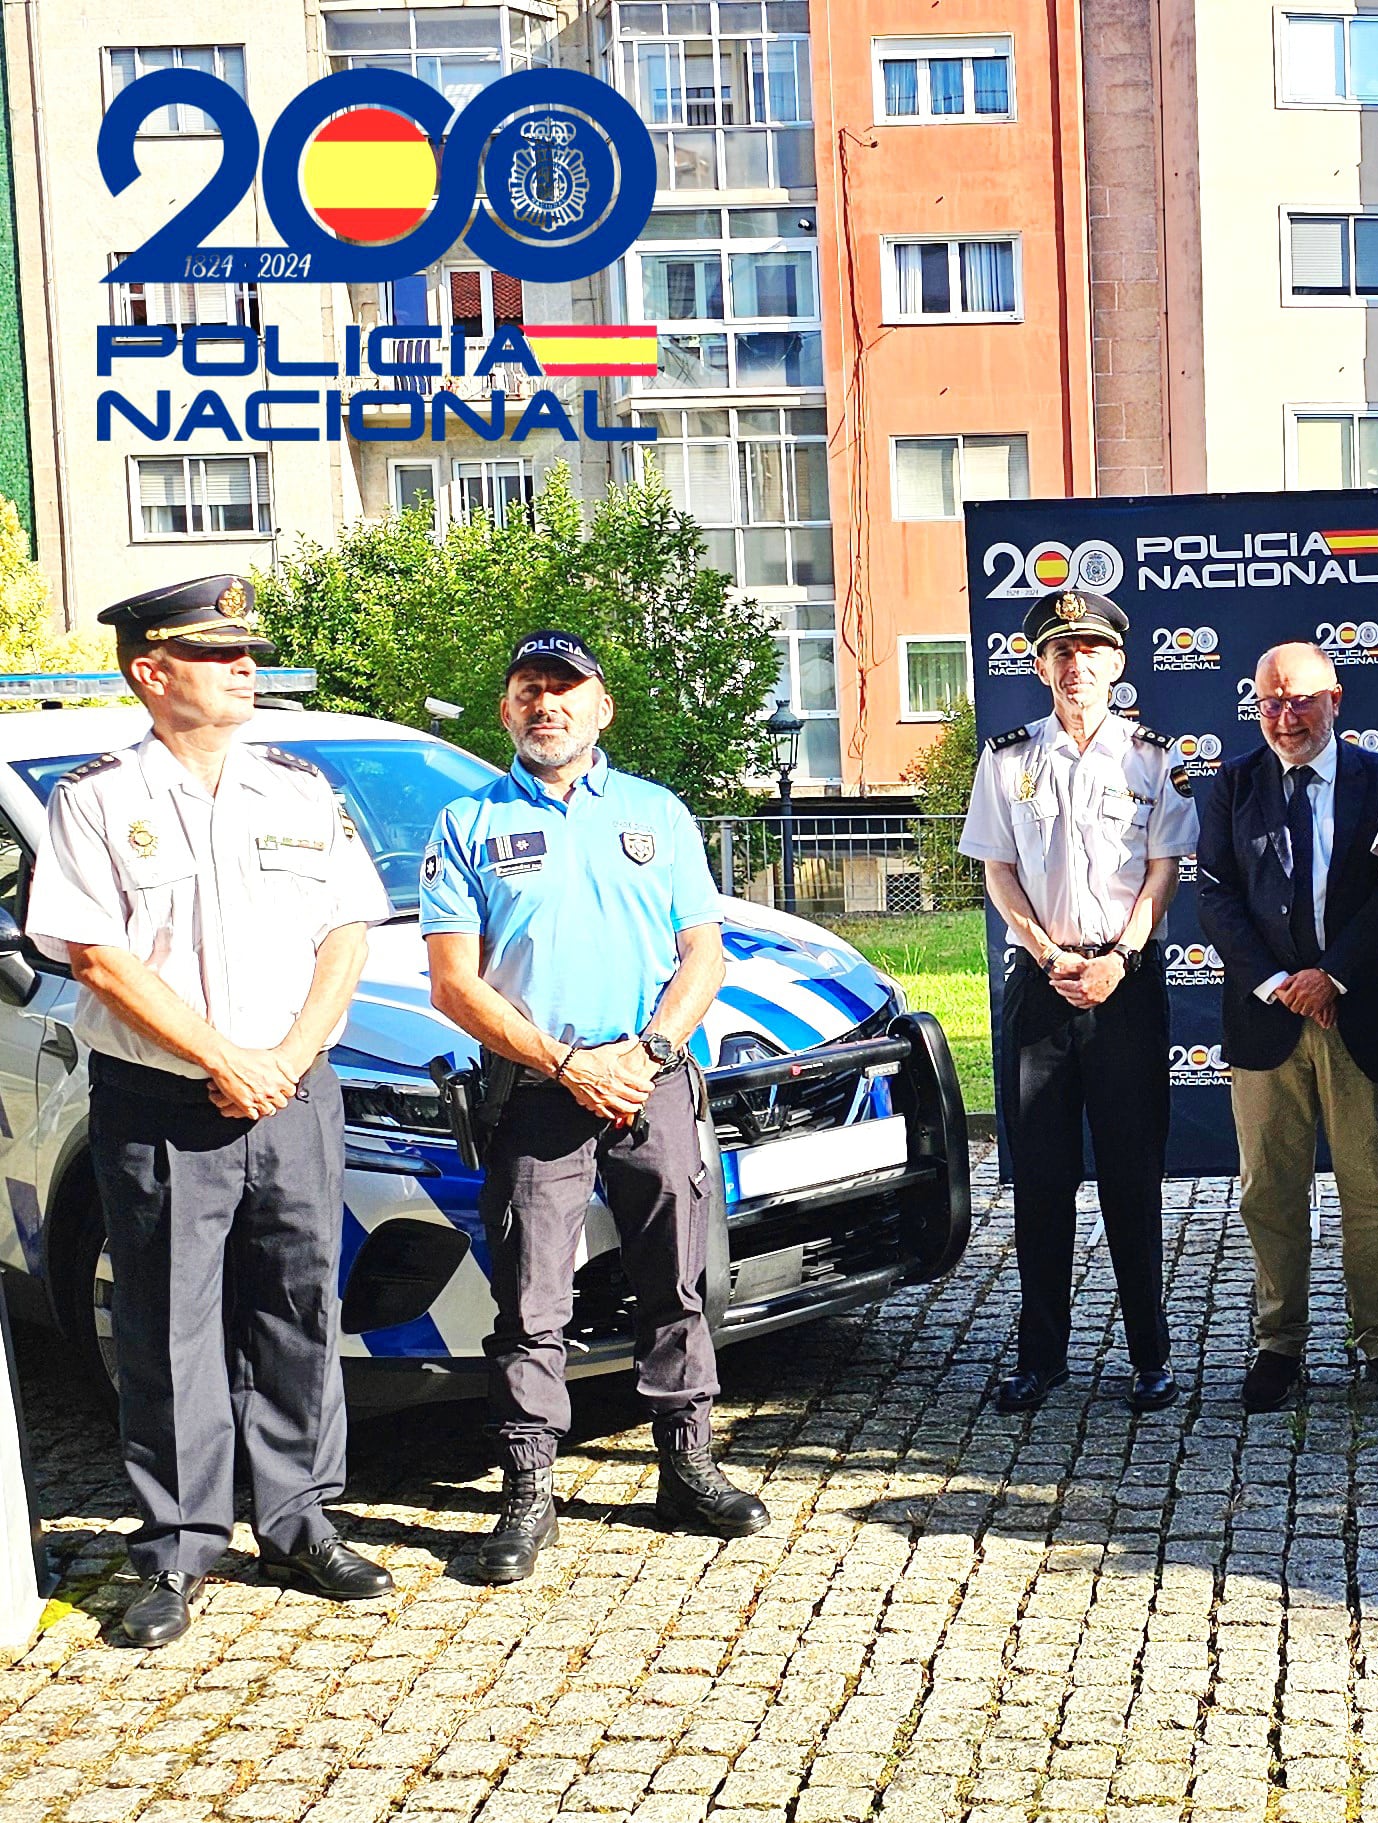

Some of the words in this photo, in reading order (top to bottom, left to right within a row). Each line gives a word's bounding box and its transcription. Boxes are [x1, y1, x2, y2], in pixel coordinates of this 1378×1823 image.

[983, 540, 1124, 599] 200
[987, 632, 1037, 660] 20
[1152, 626, 1219, 655] 200
[1327, 648, 1370, 658] OLICIA
[988, 659, 1034, 668] POLICI
[1153, 661, 1221, 672] NACIONAL
[988, 667, 1038, 676] NACION
